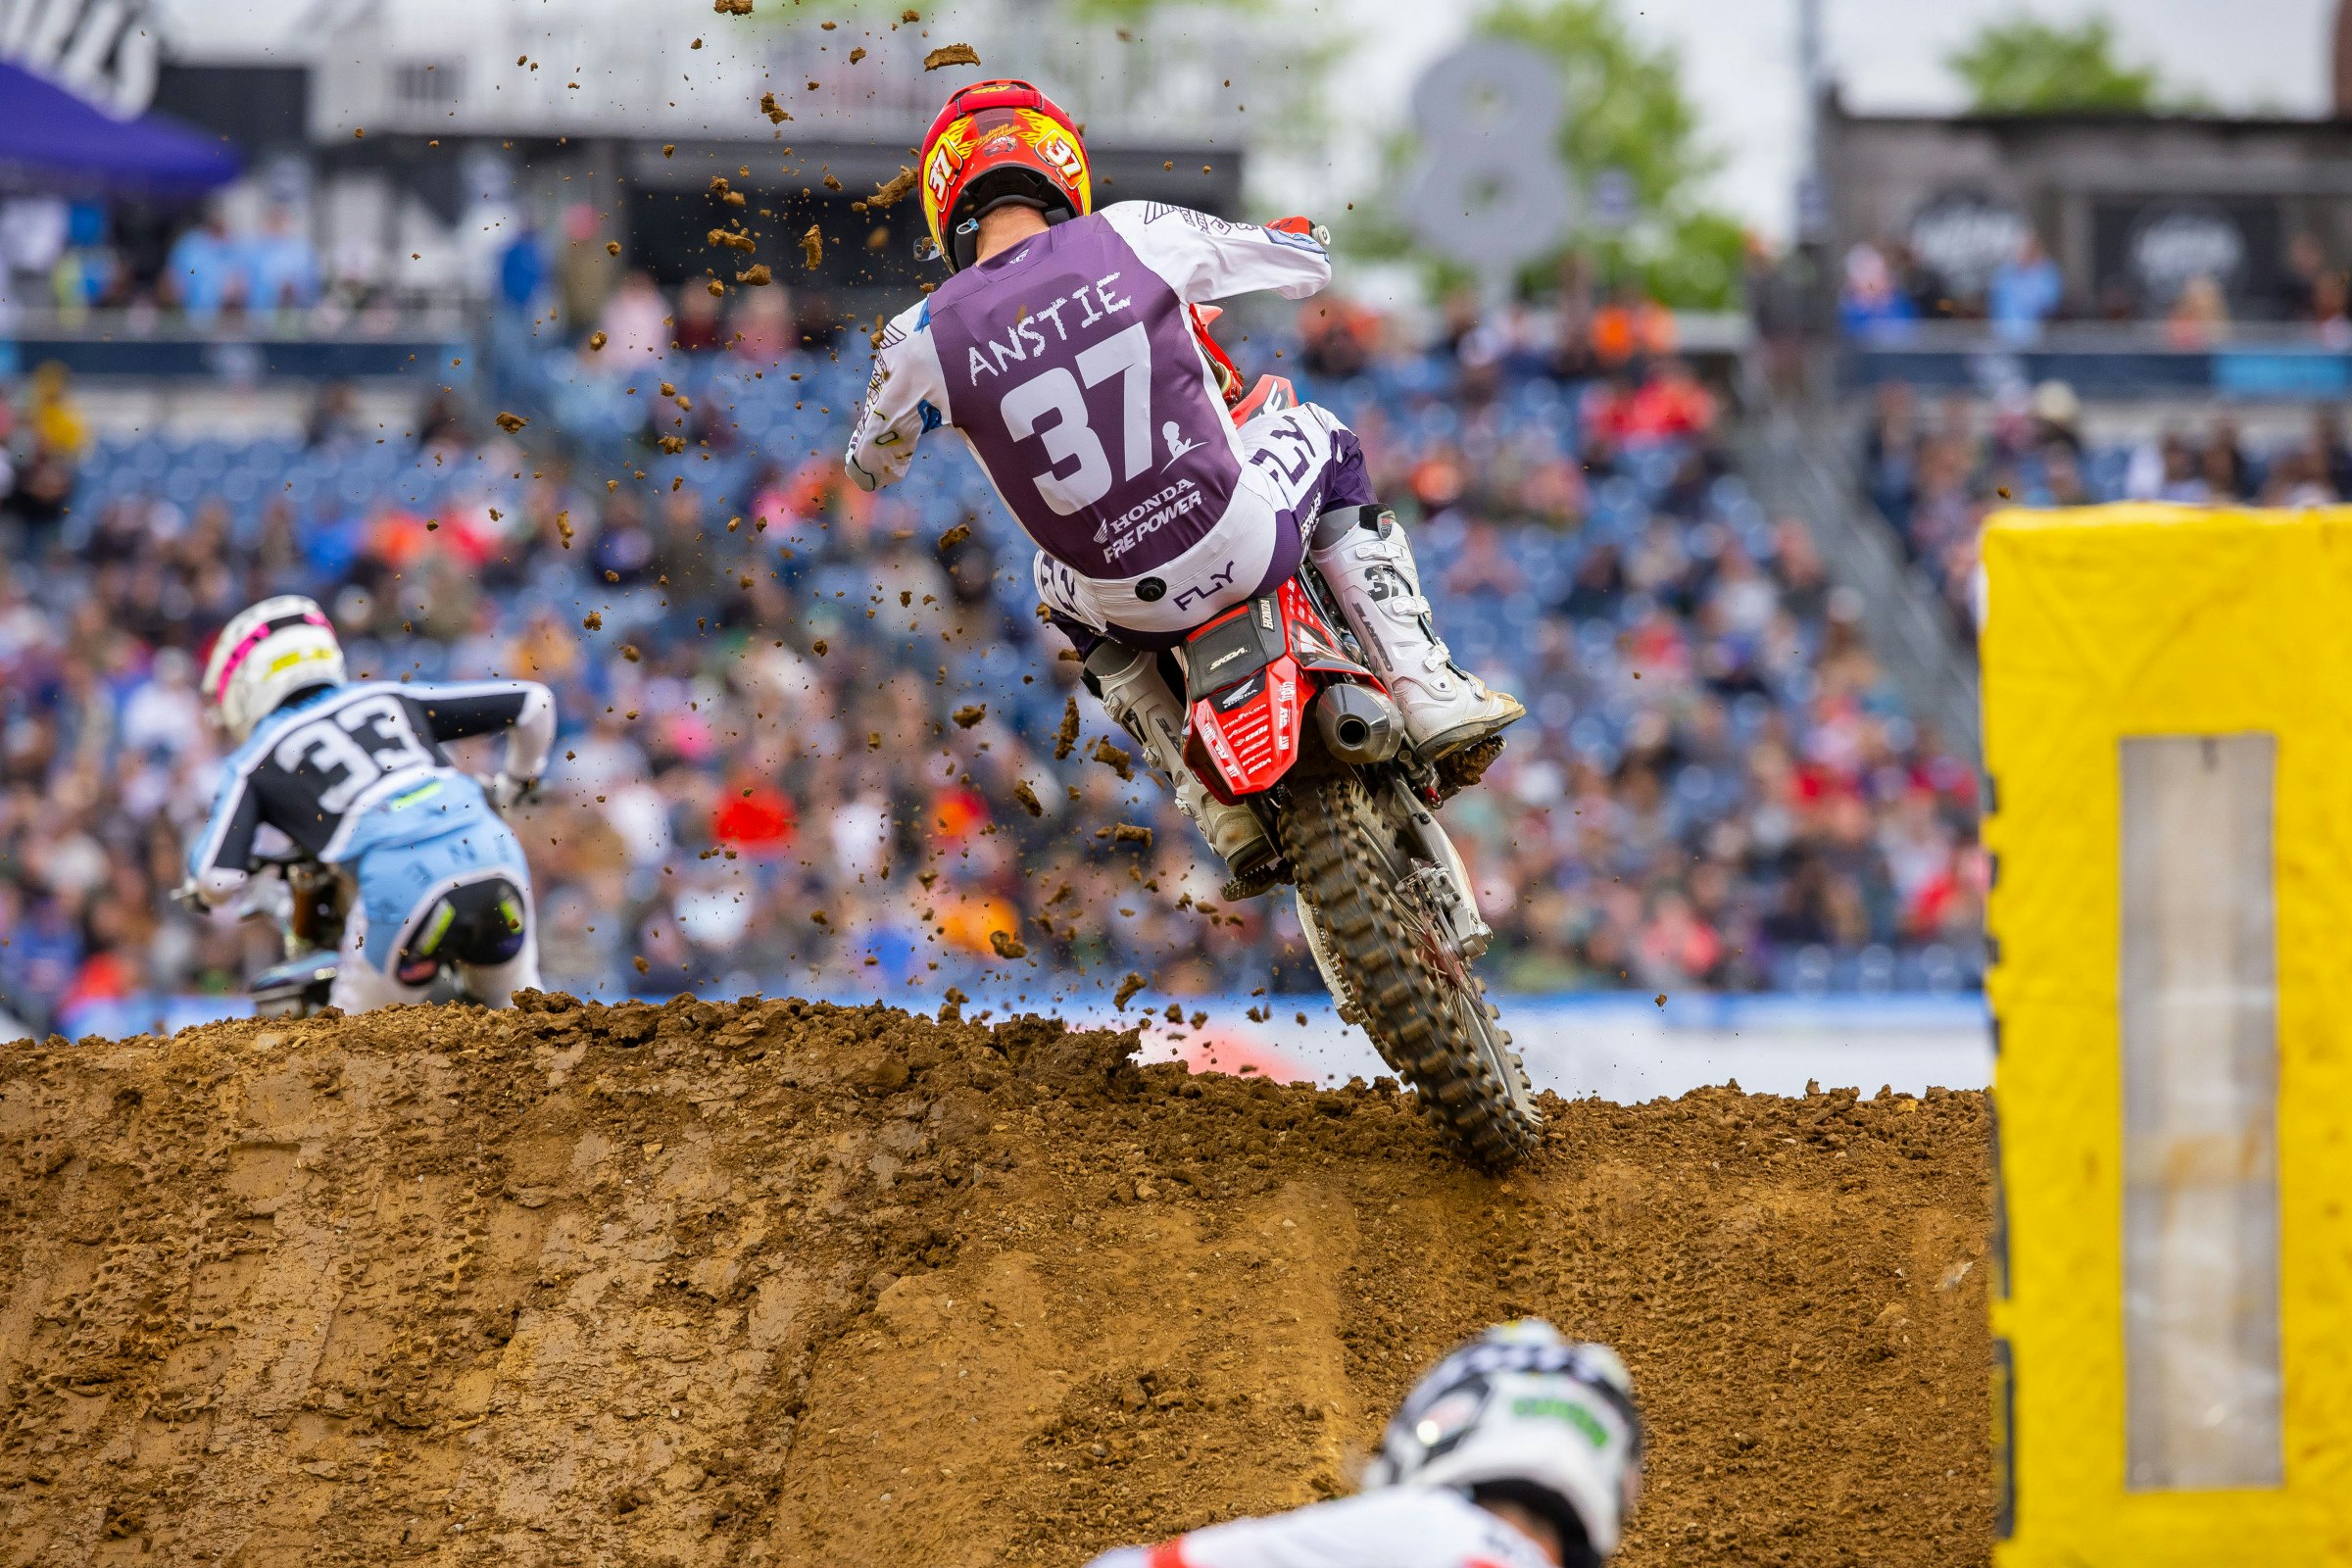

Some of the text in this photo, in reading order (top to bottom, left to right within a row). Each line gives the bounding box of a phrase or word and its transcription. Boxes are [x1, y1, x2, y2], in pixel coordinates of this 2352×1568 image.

[928, 147, 953, 202] 37
[1046, 138, 1082, 178] 37
[968, 271, 1132, 386] ANSTIE
[1000, 320, 1152, 516] 37
[1249, 415, 1316, 487] FLY
[1109, 478, 1196, 534] HONDA
[1136, 490, 1202, 543] POWER
[1173, 560, 1235, 612] FLY
[1260, 599, 1275, 630] HONDA
[1223, 688, 1258, 709] HONDA
[274, 694, 437, 814] 33
